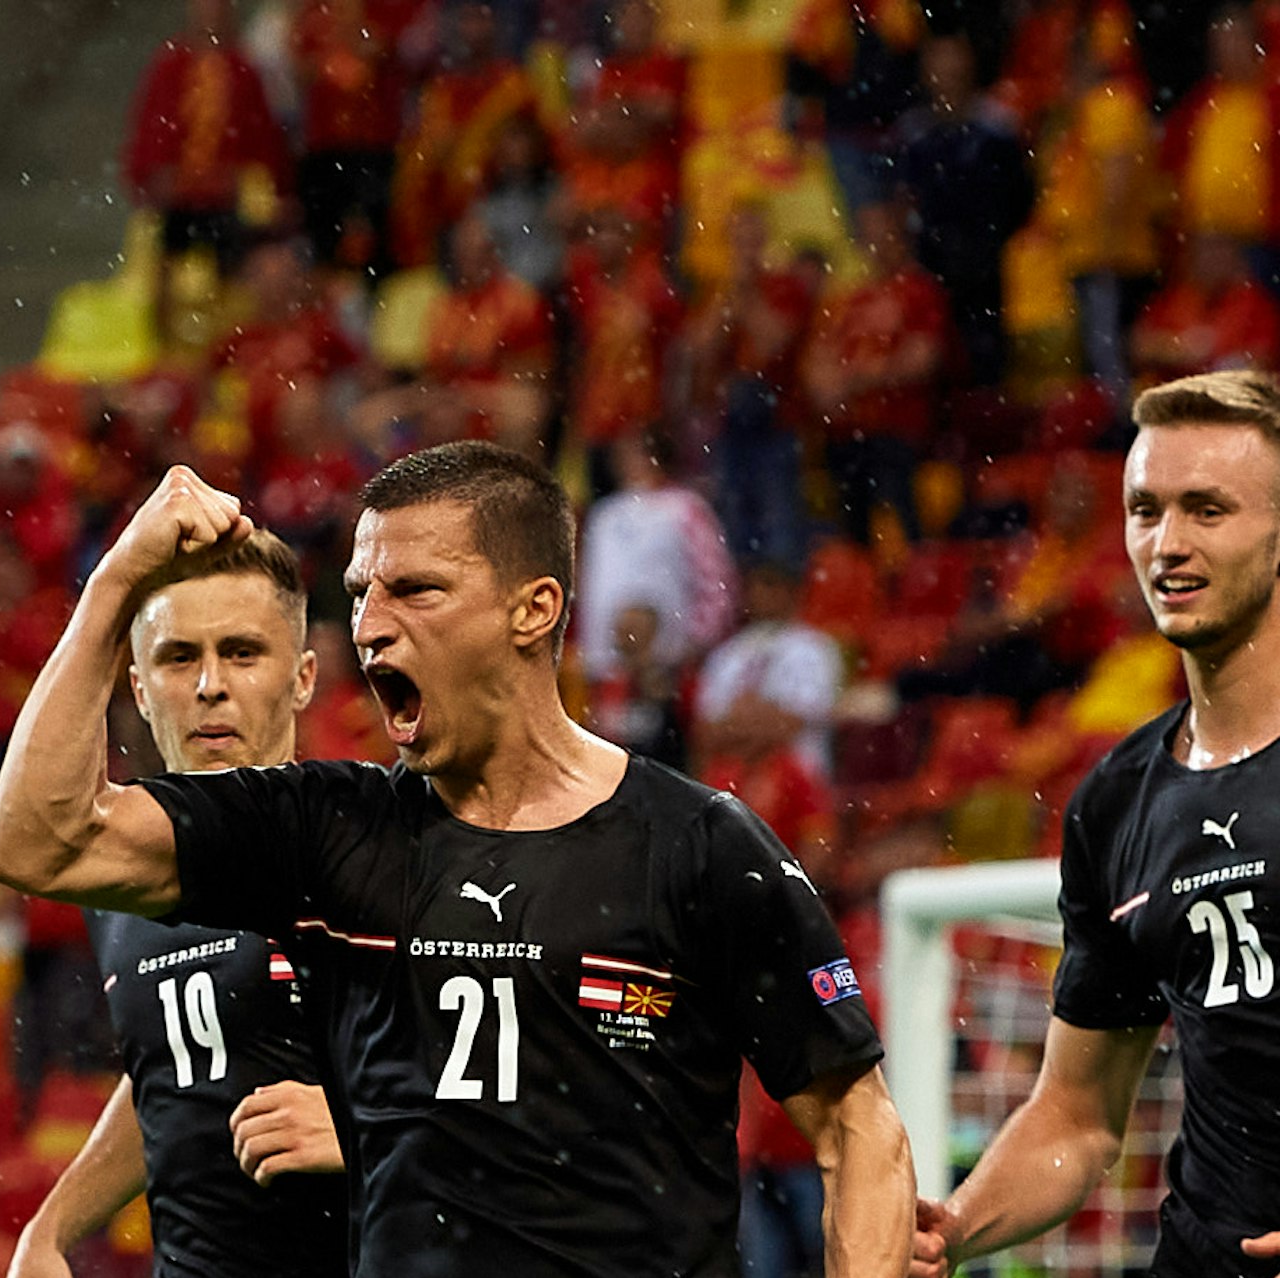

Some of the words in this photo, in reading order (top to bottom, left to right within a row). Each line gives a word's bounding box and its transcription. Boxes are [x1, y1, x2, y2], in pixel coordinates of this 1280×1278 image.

[1172, 860, 1265, 894] ÖSTERREICH
[137, 937, 237, 975] ÖSTERREICH
[409, 937, 543, 960] ÖSTERREICH
[1186, 891, 1274, 1008] 25
[158, 971, 227, 1089] 19
[435, 976, 519, 1102] 21
